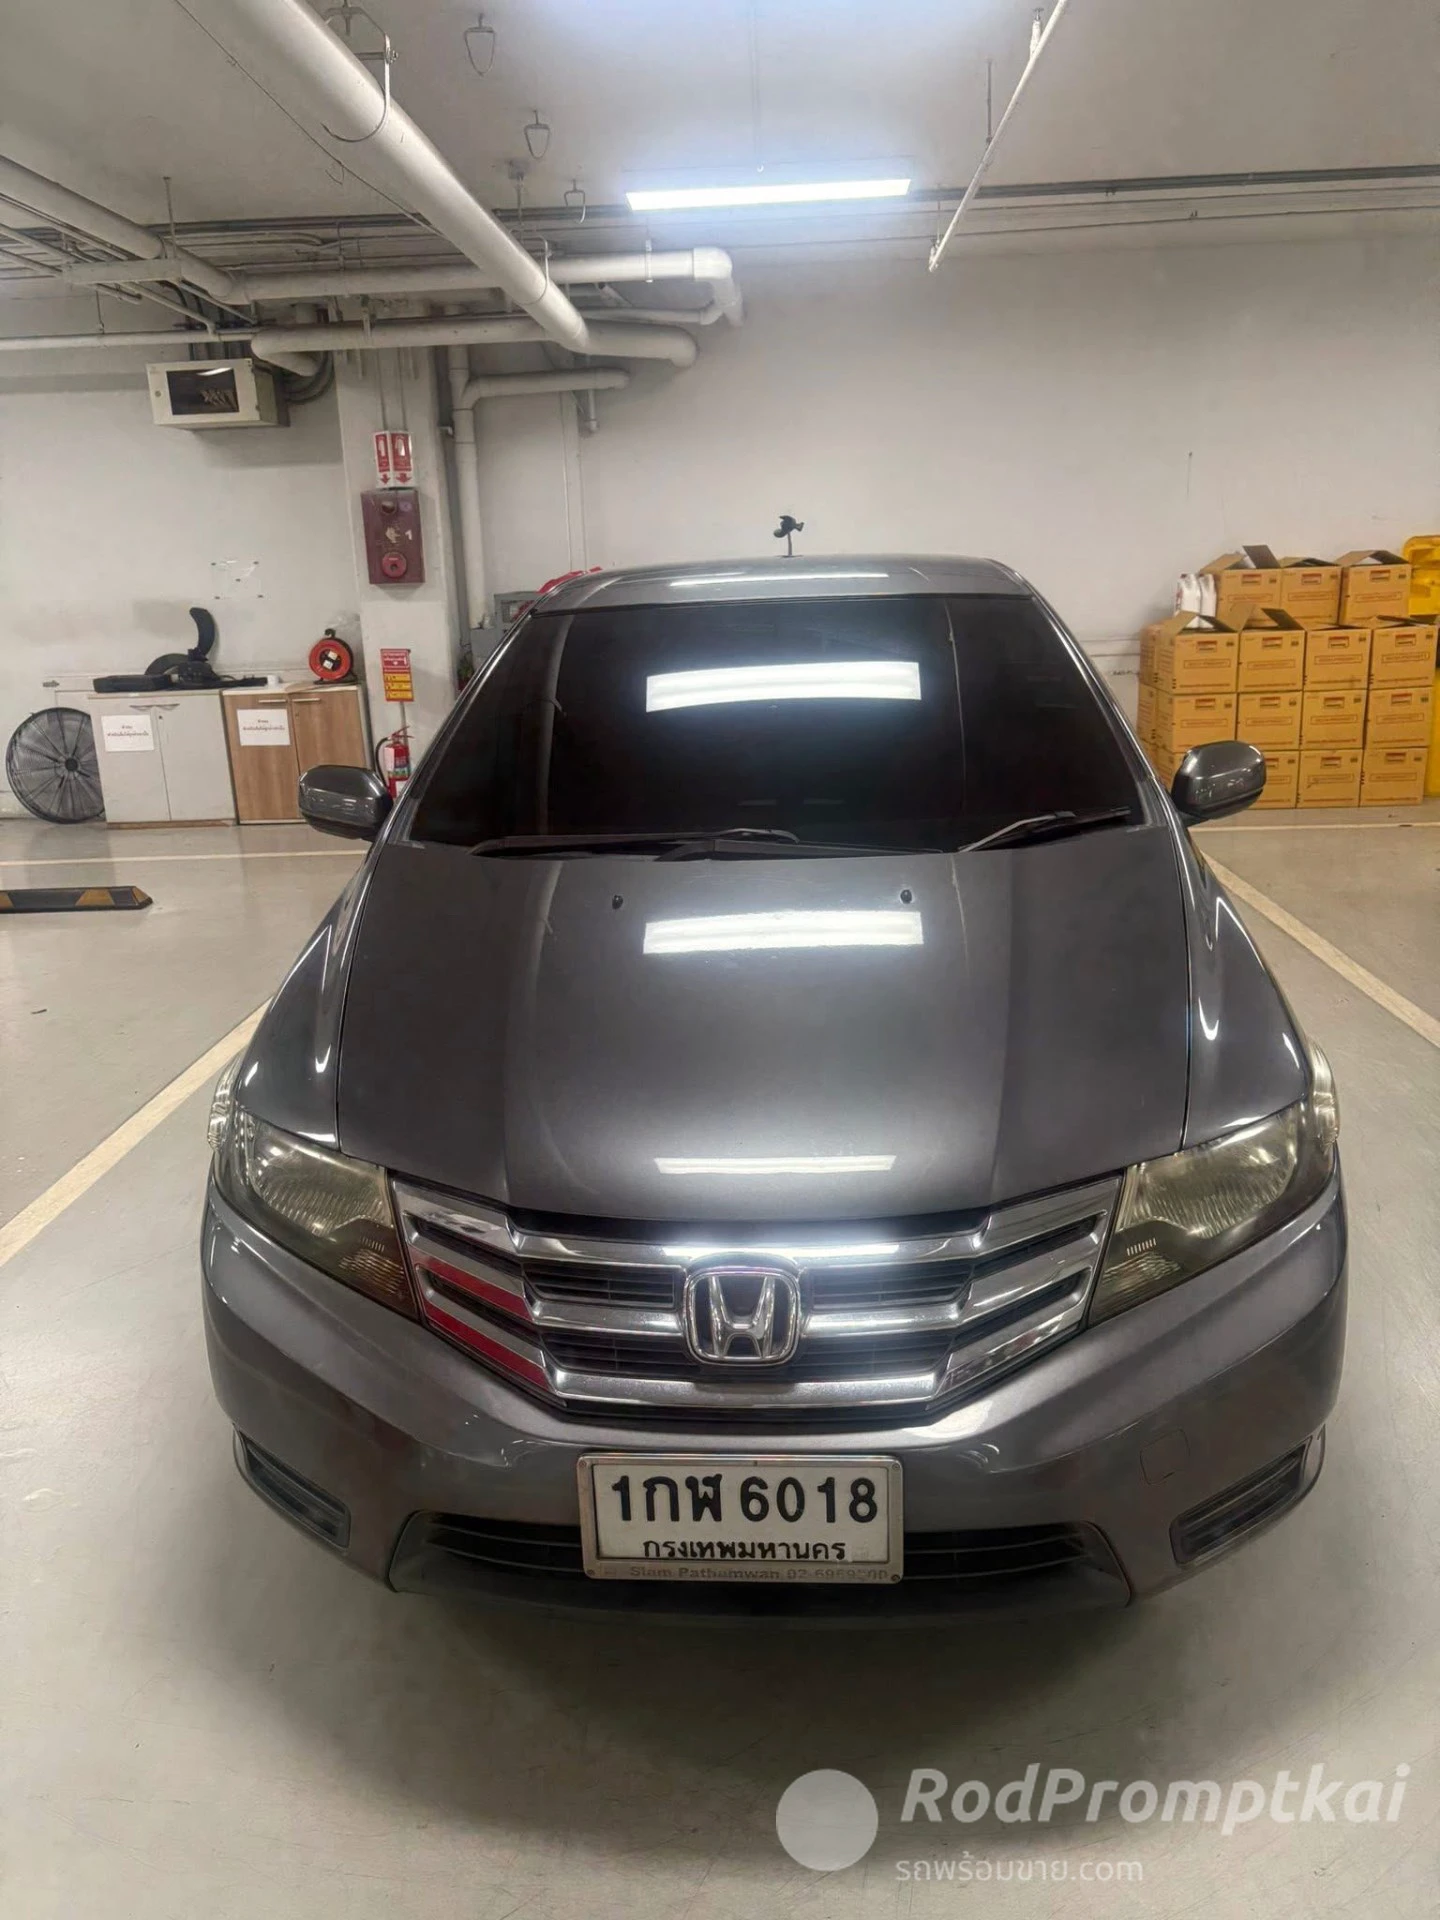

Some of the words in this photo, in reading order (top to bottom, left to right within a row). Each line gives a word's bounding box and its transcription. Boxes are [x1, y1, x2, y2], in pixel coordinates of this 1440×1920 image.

[612, 1474, 723, 1522] 1กฬ
[740, 1476, 878, 1523] 6018
[643, 1540, 846, 1560] กรงเทพมหานคร
